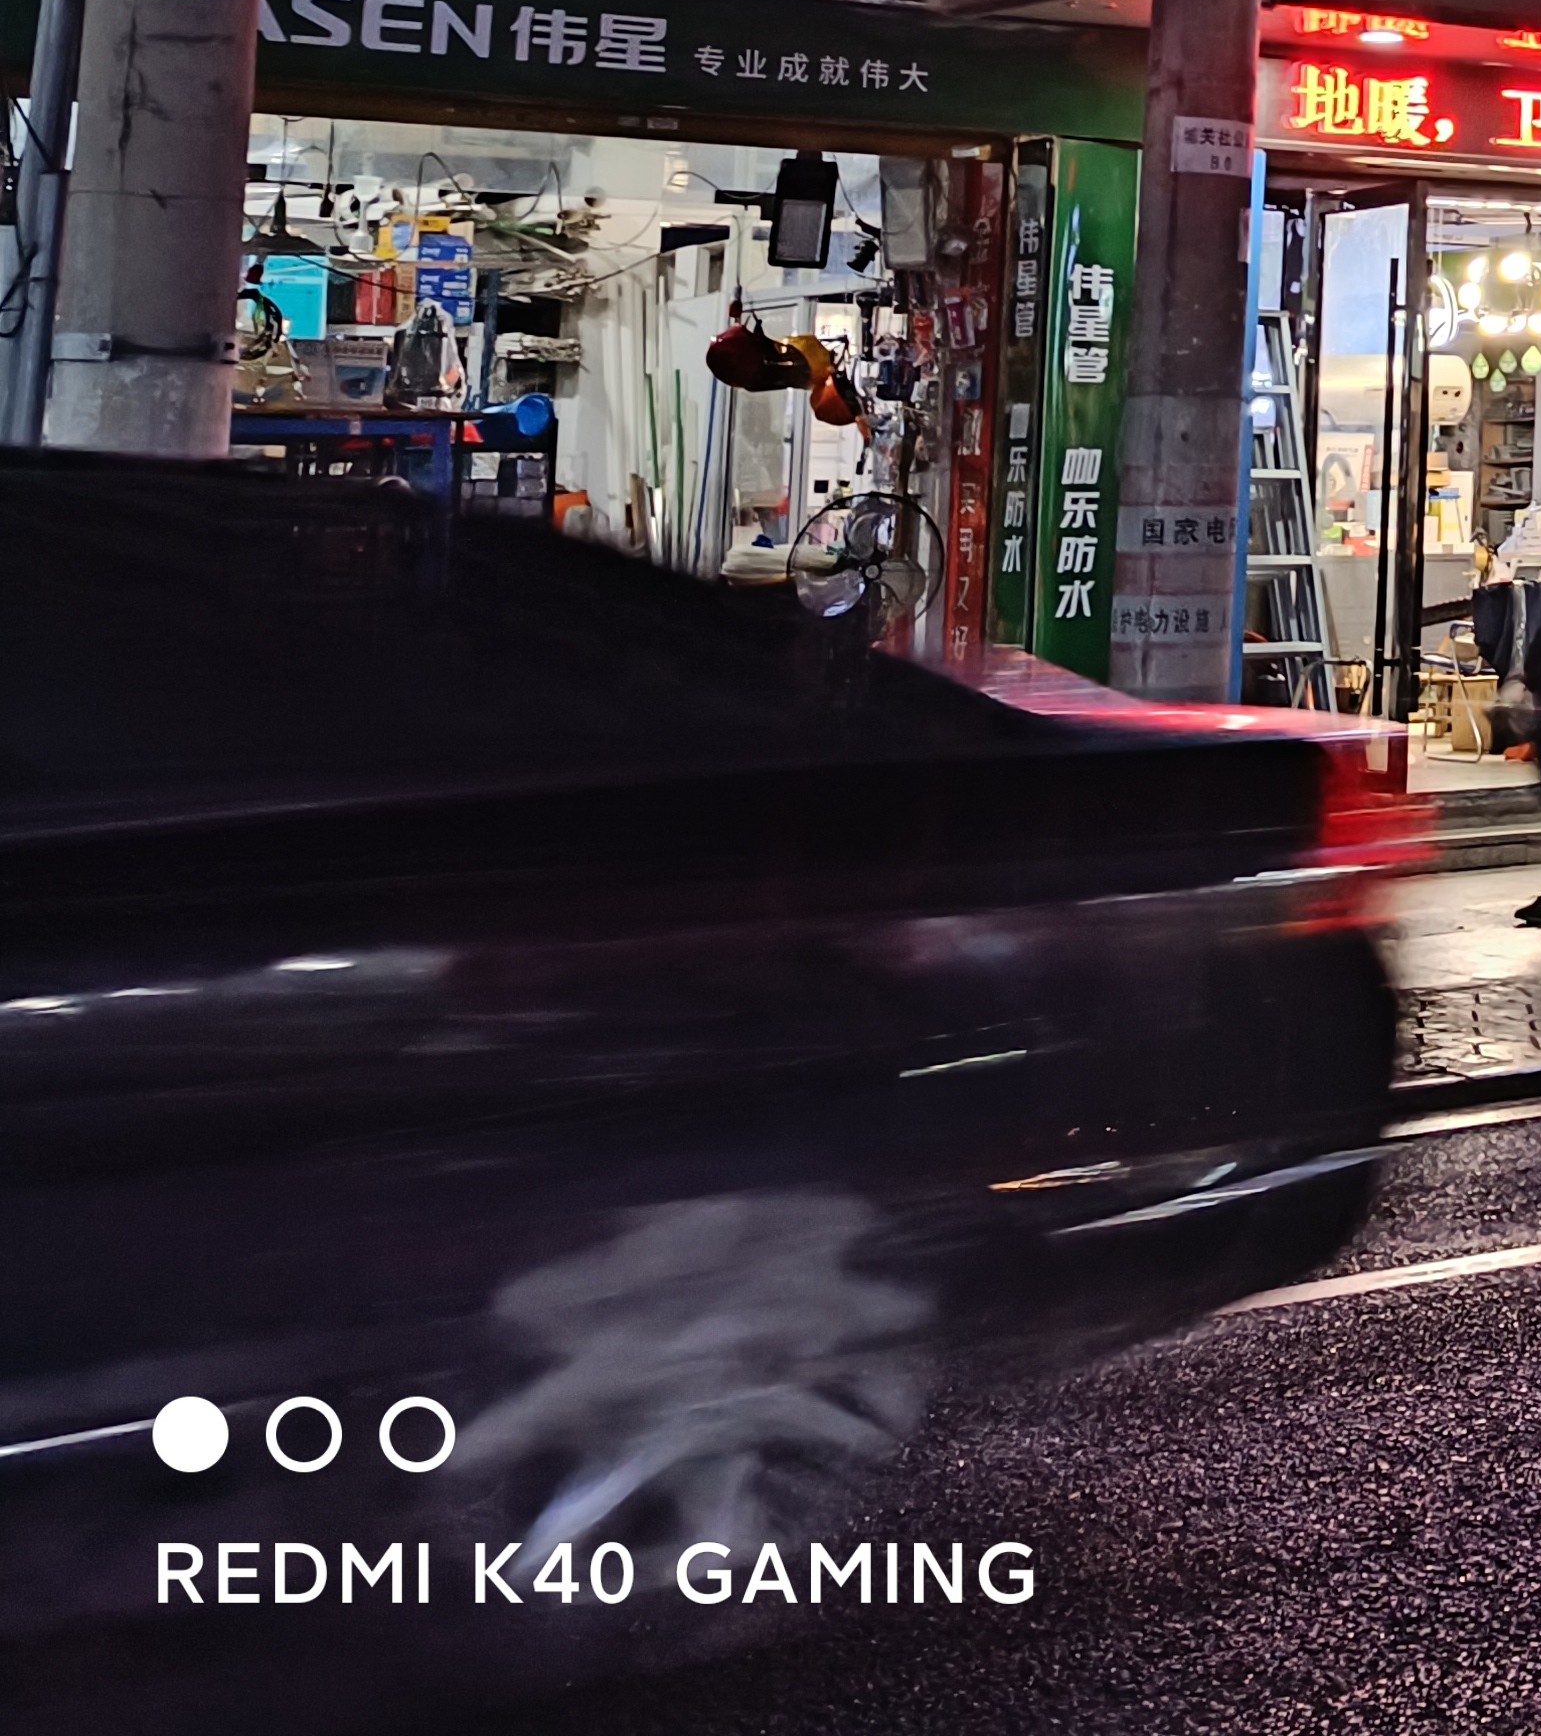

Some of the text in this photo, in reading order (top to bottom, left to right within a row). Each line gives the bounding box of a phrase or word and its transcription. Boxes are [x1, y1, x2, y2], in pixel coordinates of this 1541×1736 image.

[509, 5, 668, 74] 伟星
[694, 44, 930, 93] 专业成就伟大
[1065, 264, 1114, 385] 伟星管
[1001, 402, 1031, 573] 乐防水
[1055, 447, 1102, 619] 咖乐防水
[1142, 516, 1237, 546] 国家电
